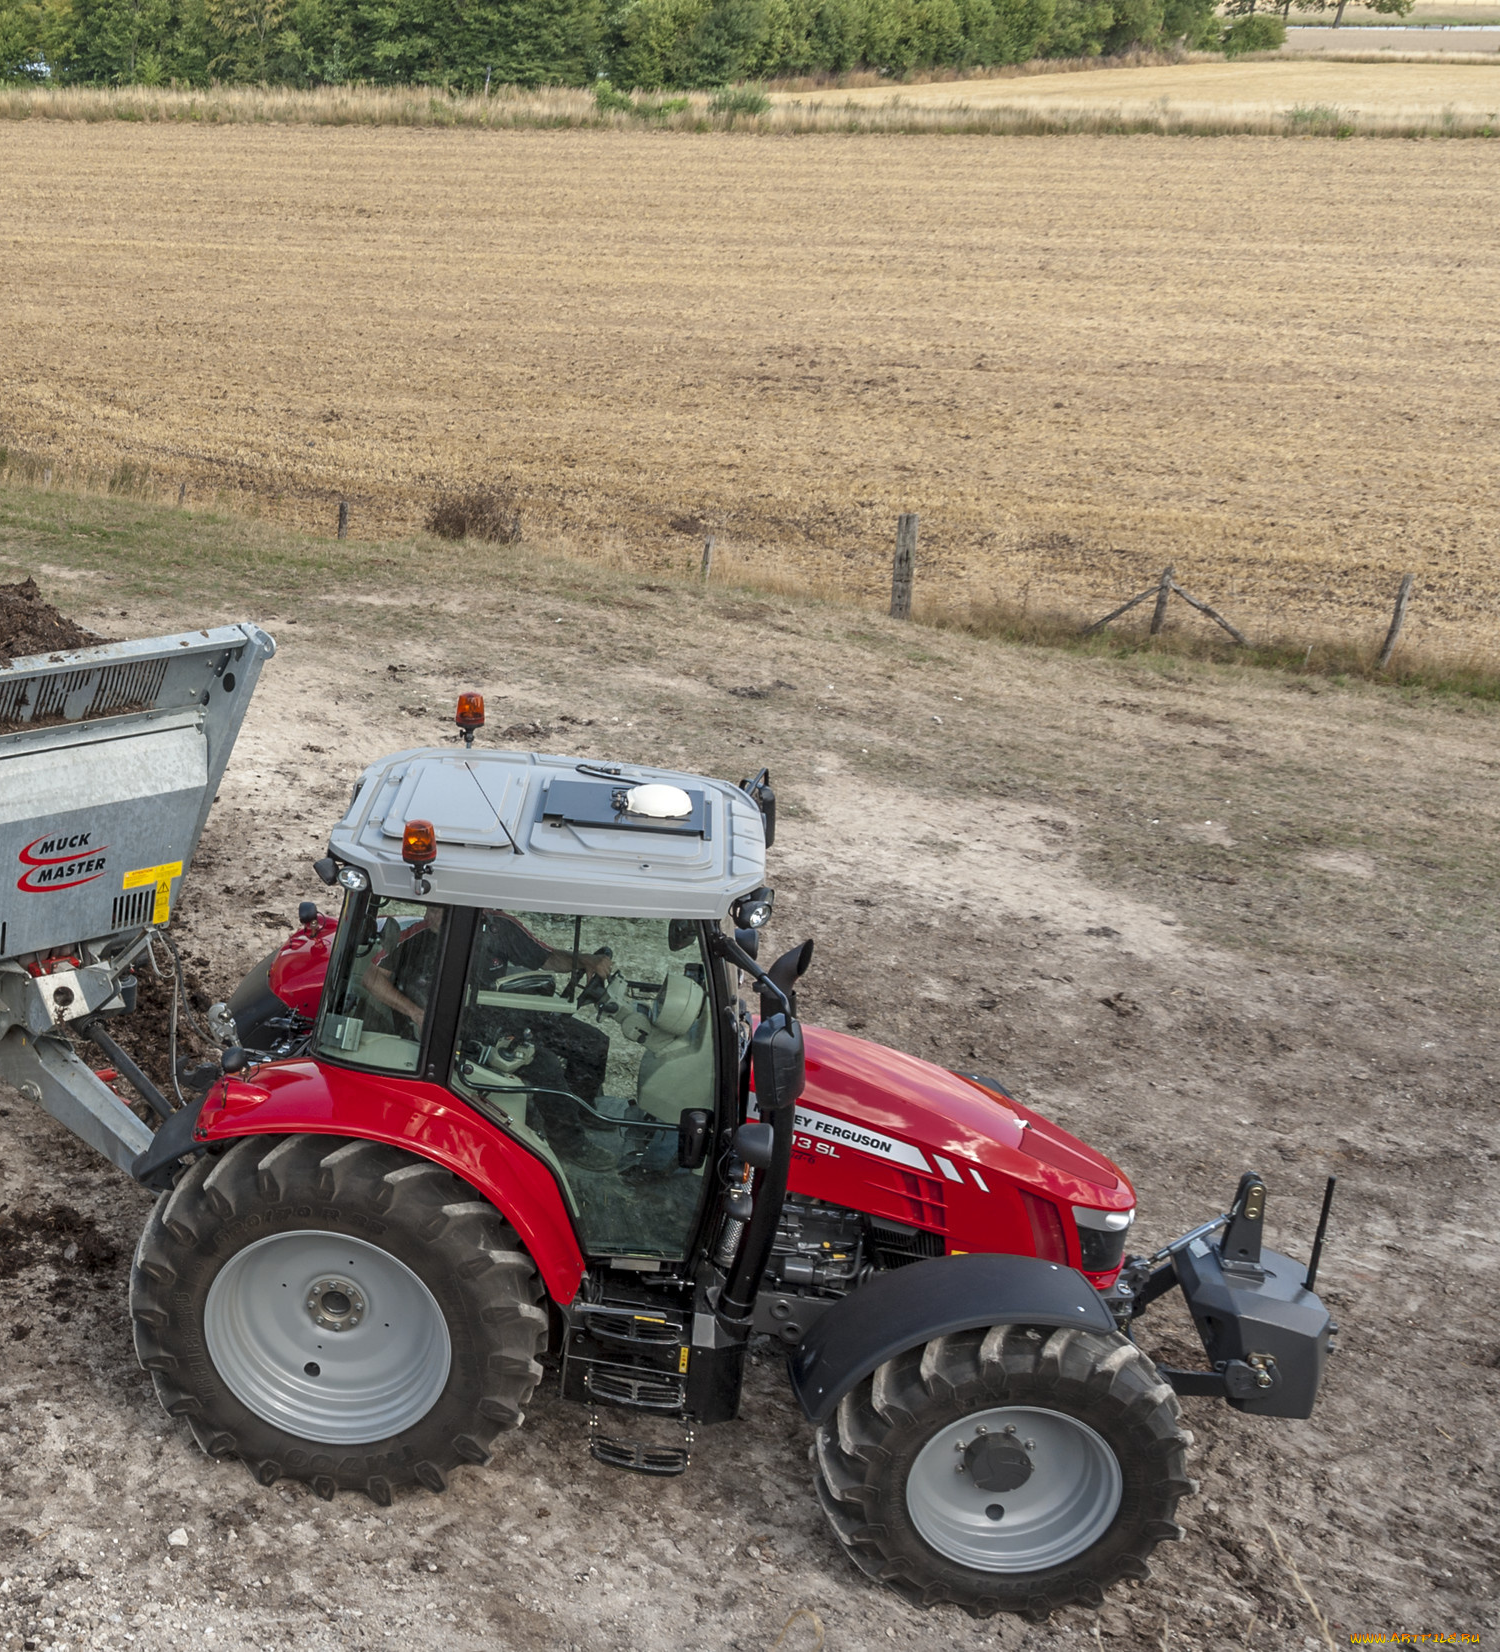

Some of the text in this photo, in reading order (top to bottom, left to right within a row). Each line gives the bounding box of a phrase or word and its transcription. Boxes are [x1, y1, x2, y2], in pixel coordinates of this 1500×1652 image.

[39, 832, 92, 854] MUCK
[37, 858, 106, 883] MASTER
[815, 1121, 892, 1153] FERGUSON
[815, 1143, 840, 1158] SL
